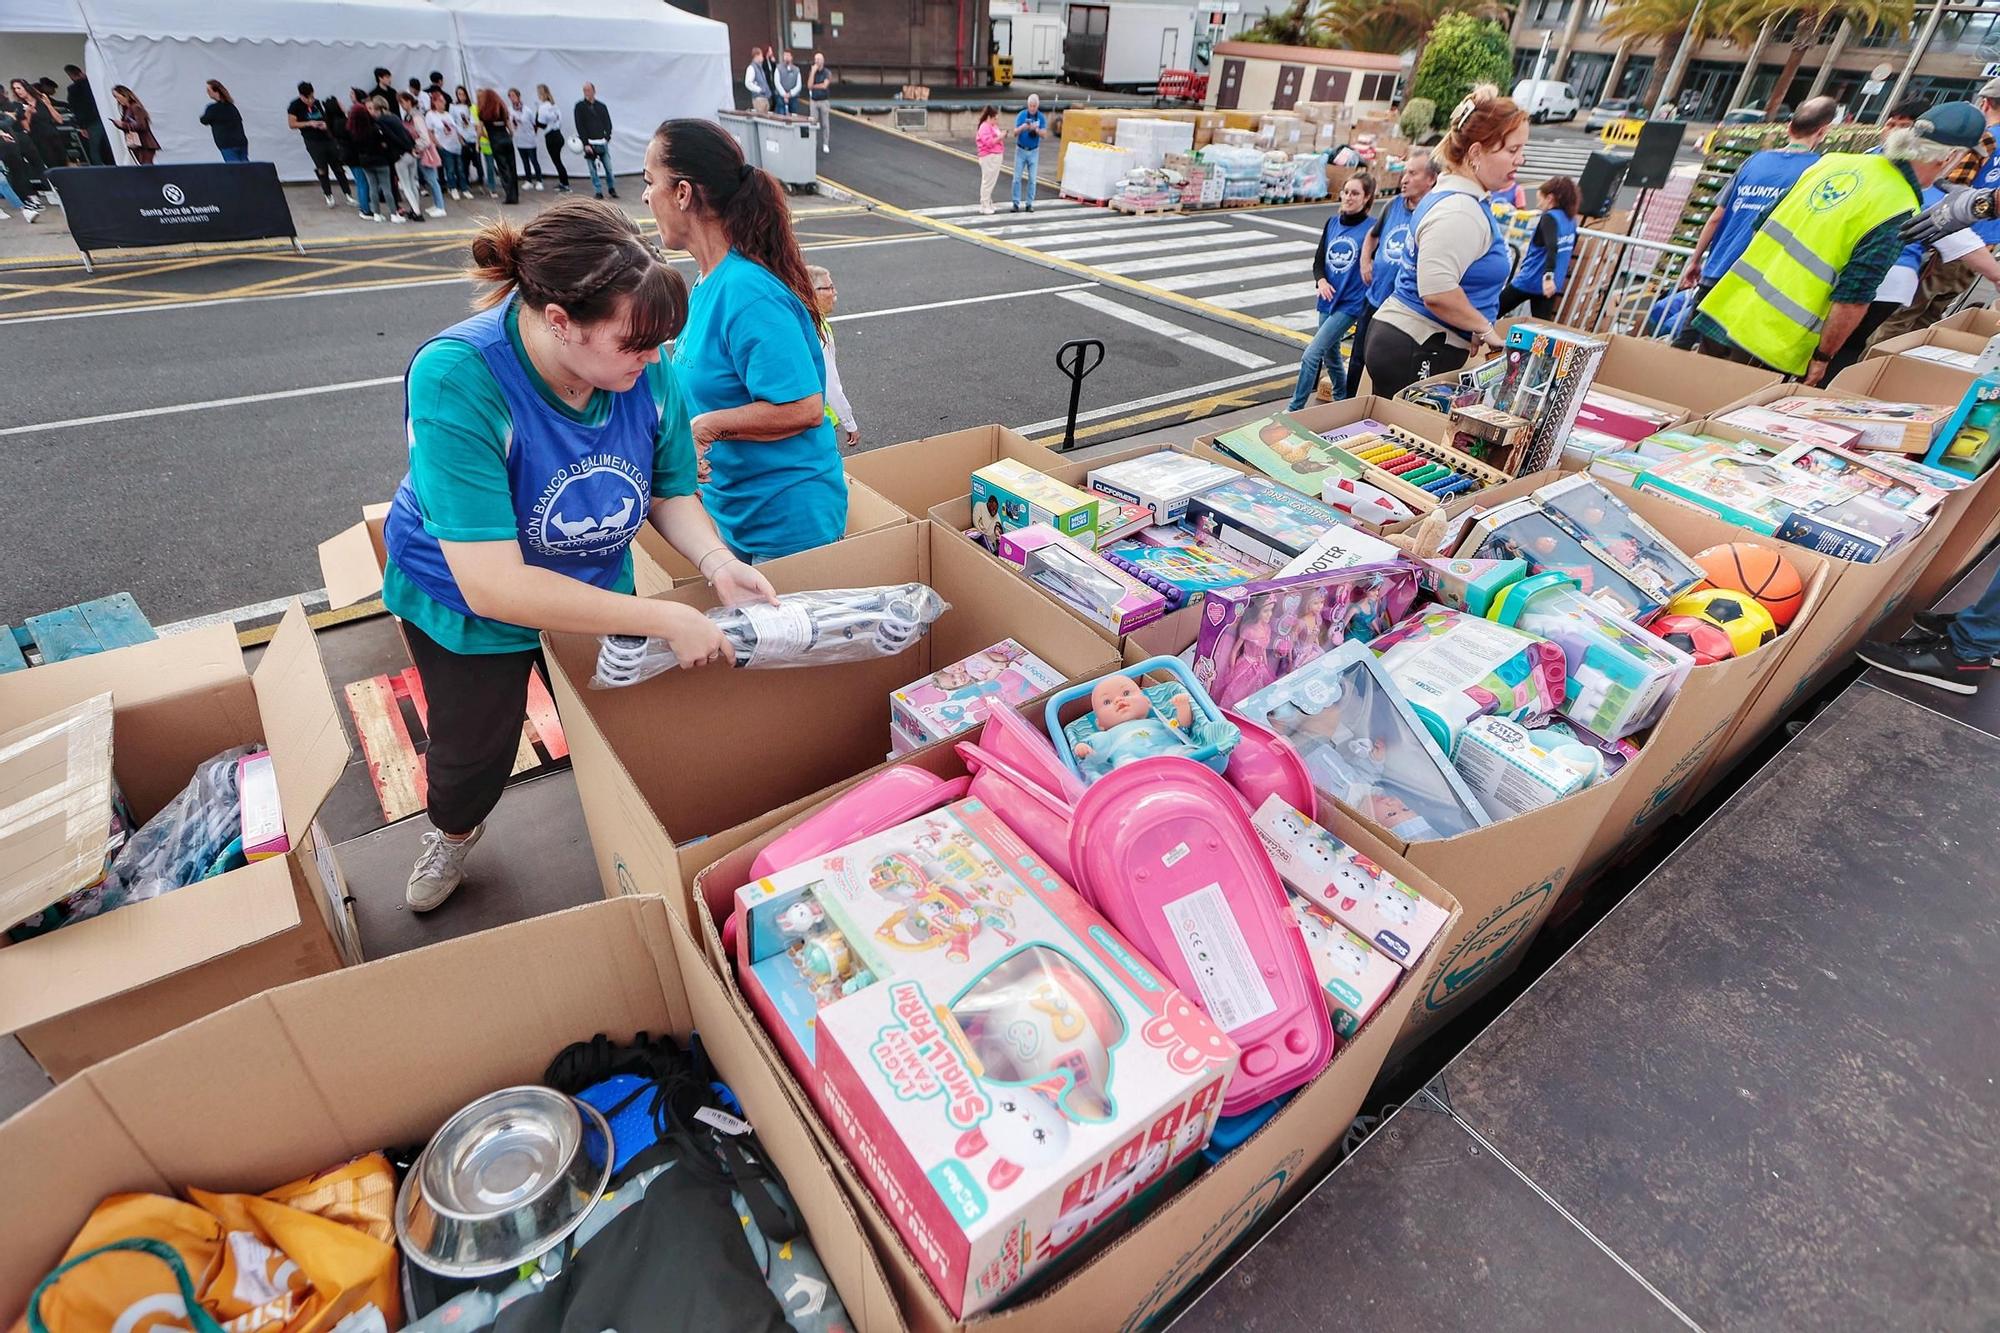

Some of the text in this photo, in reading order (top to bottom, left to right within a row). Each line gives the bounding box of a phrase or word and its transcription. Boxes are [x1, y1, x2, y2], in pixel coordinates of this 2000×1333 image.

[140, 205, 220, 217] Santa Cruz de Tenerife
[160, 215, 210, 224] AYUNTAMIENTO
[533, 468, 567, 513] BANCO
[570, 459, 589, 475] DE
[585, 453, 650, 491] ALIMENTOS
[1071, 512, 1087, 523] MEGA
[1071, 519, 1088, 529] BLOKS
[1300, 546, 1347, 576] OOTER
[895, 985, 939, 1046] FARM
[877, 1044, 916, 1094] LAGU
[886, 1031, 935, 1093] FAMILY
[927, 1039, 985, 1123] SMALL
[859, 1138, 905, 1216] FAMILY
[908, 1215, 949, 1279] LAGU
